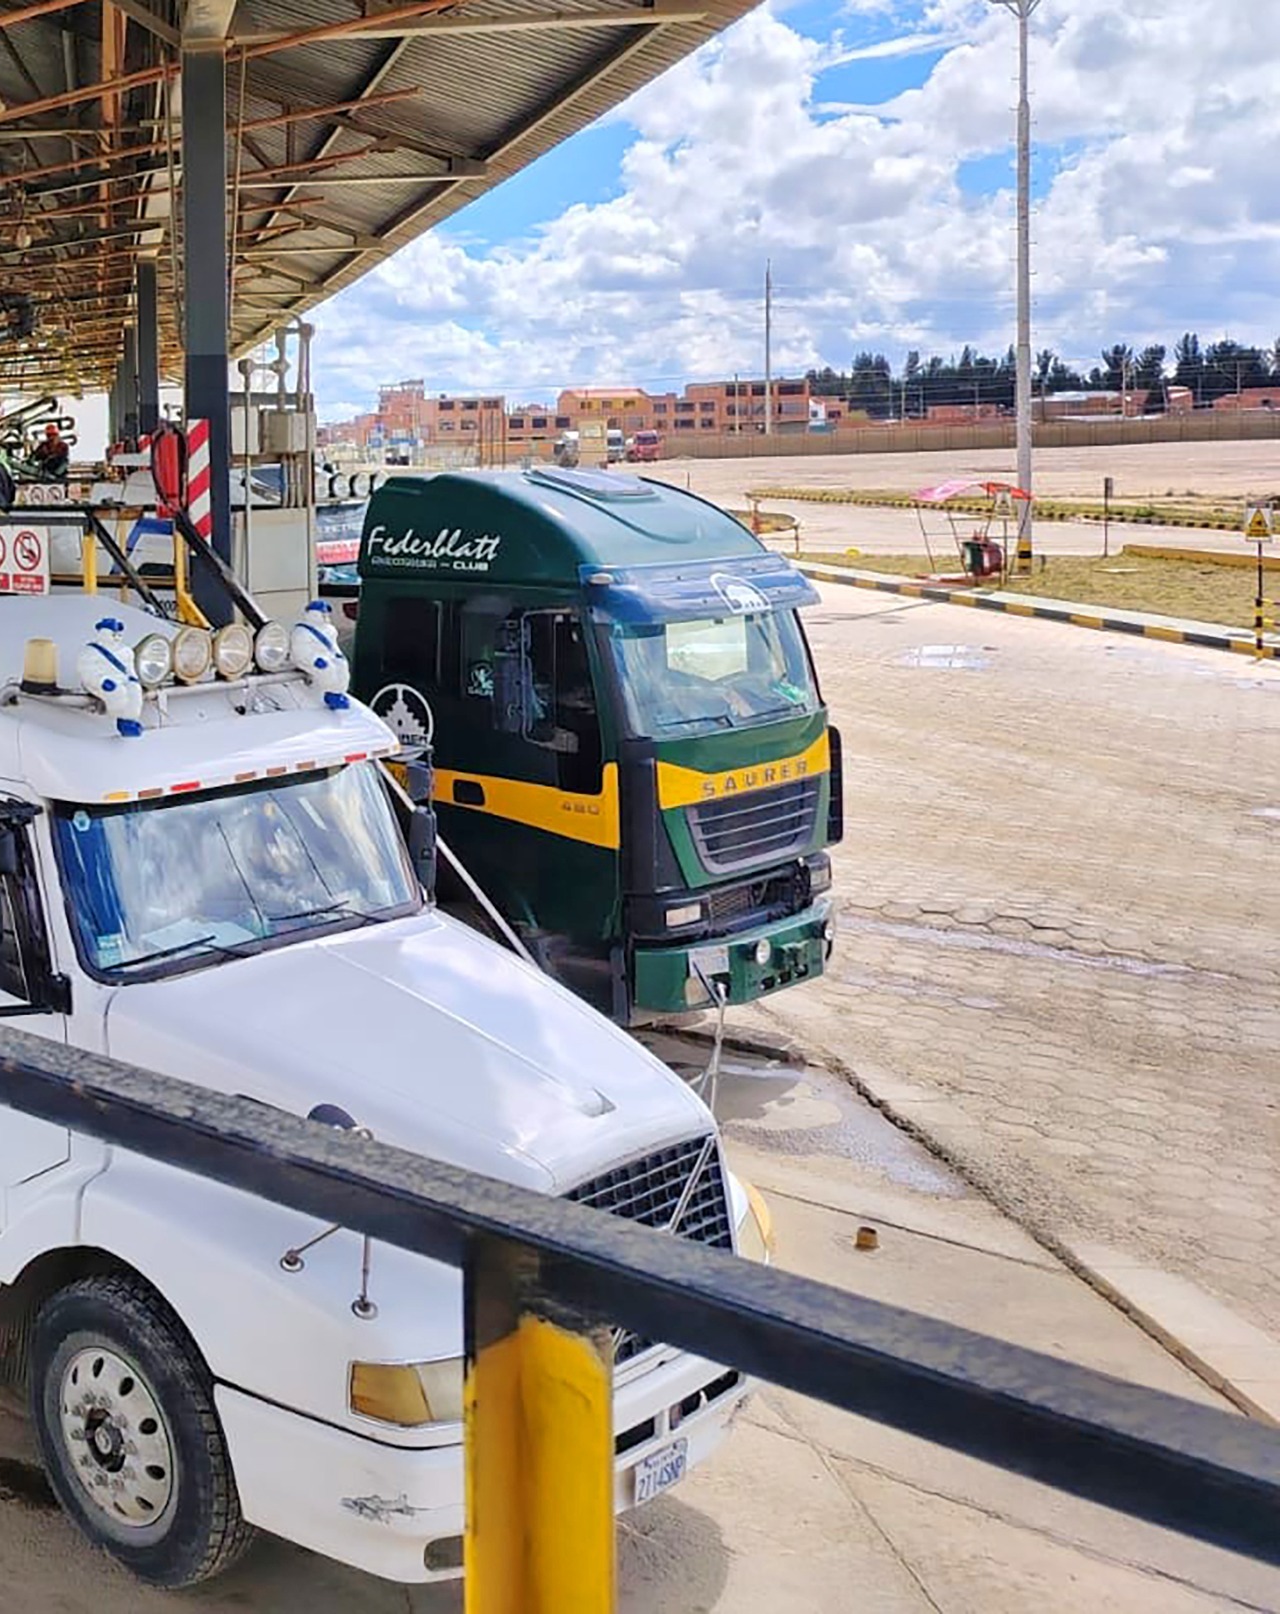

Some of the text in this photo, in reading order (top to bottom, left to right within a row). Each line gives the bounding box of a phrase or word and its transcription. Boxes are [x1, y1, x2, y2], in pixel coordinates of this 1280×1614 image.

[367, 525, 501, 561] Federblatt
[452, 560, 489, 571] CLUB
[702, 761, 807, 797] SAURER
